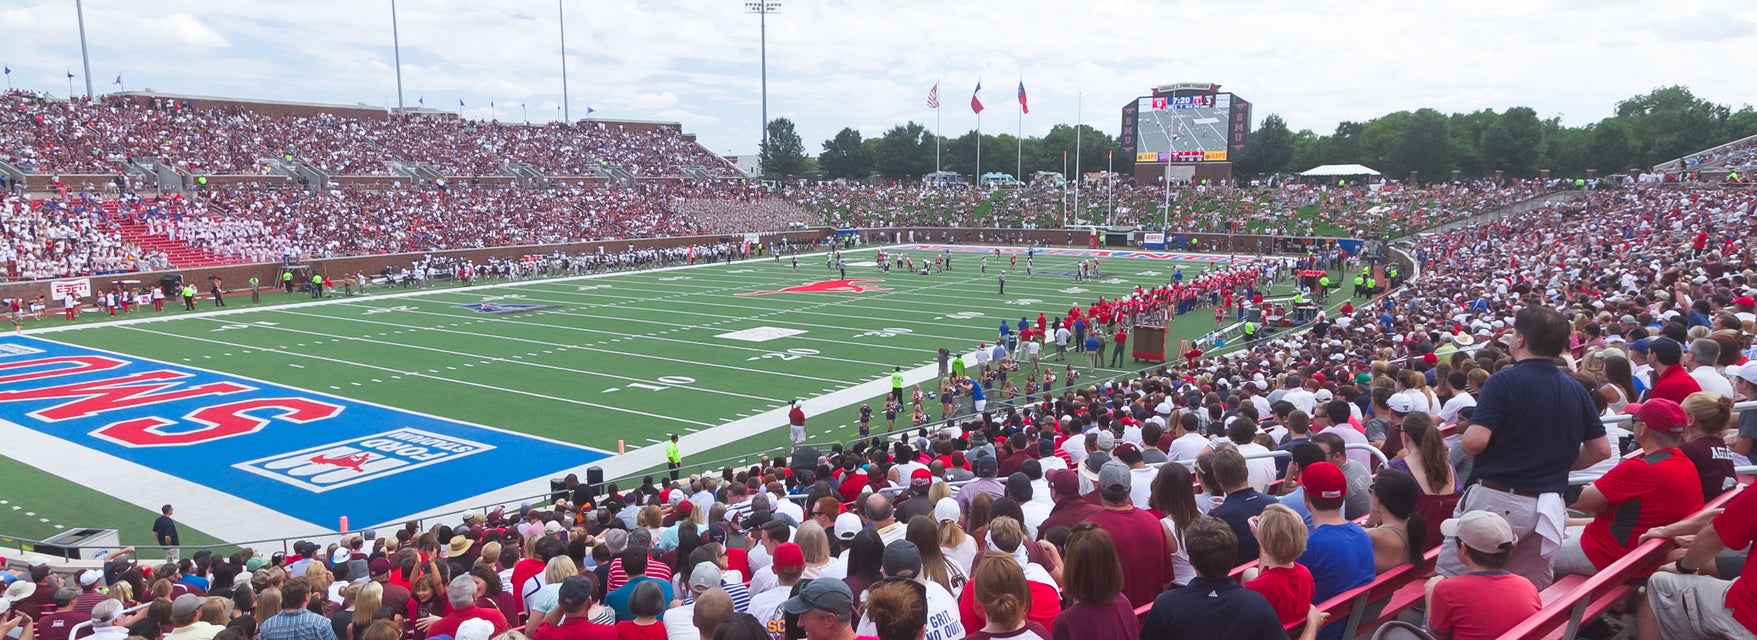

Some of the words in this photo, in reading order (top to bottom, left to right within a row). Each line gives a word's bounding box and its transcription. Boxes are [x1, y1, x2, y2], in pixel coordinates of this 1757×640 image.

[762, 348, 821, 361] 20
[626, 376, 696, 392] 10
[359, 438, 449, 462] FORD
[387, 430, 475, 454] STADIUM
